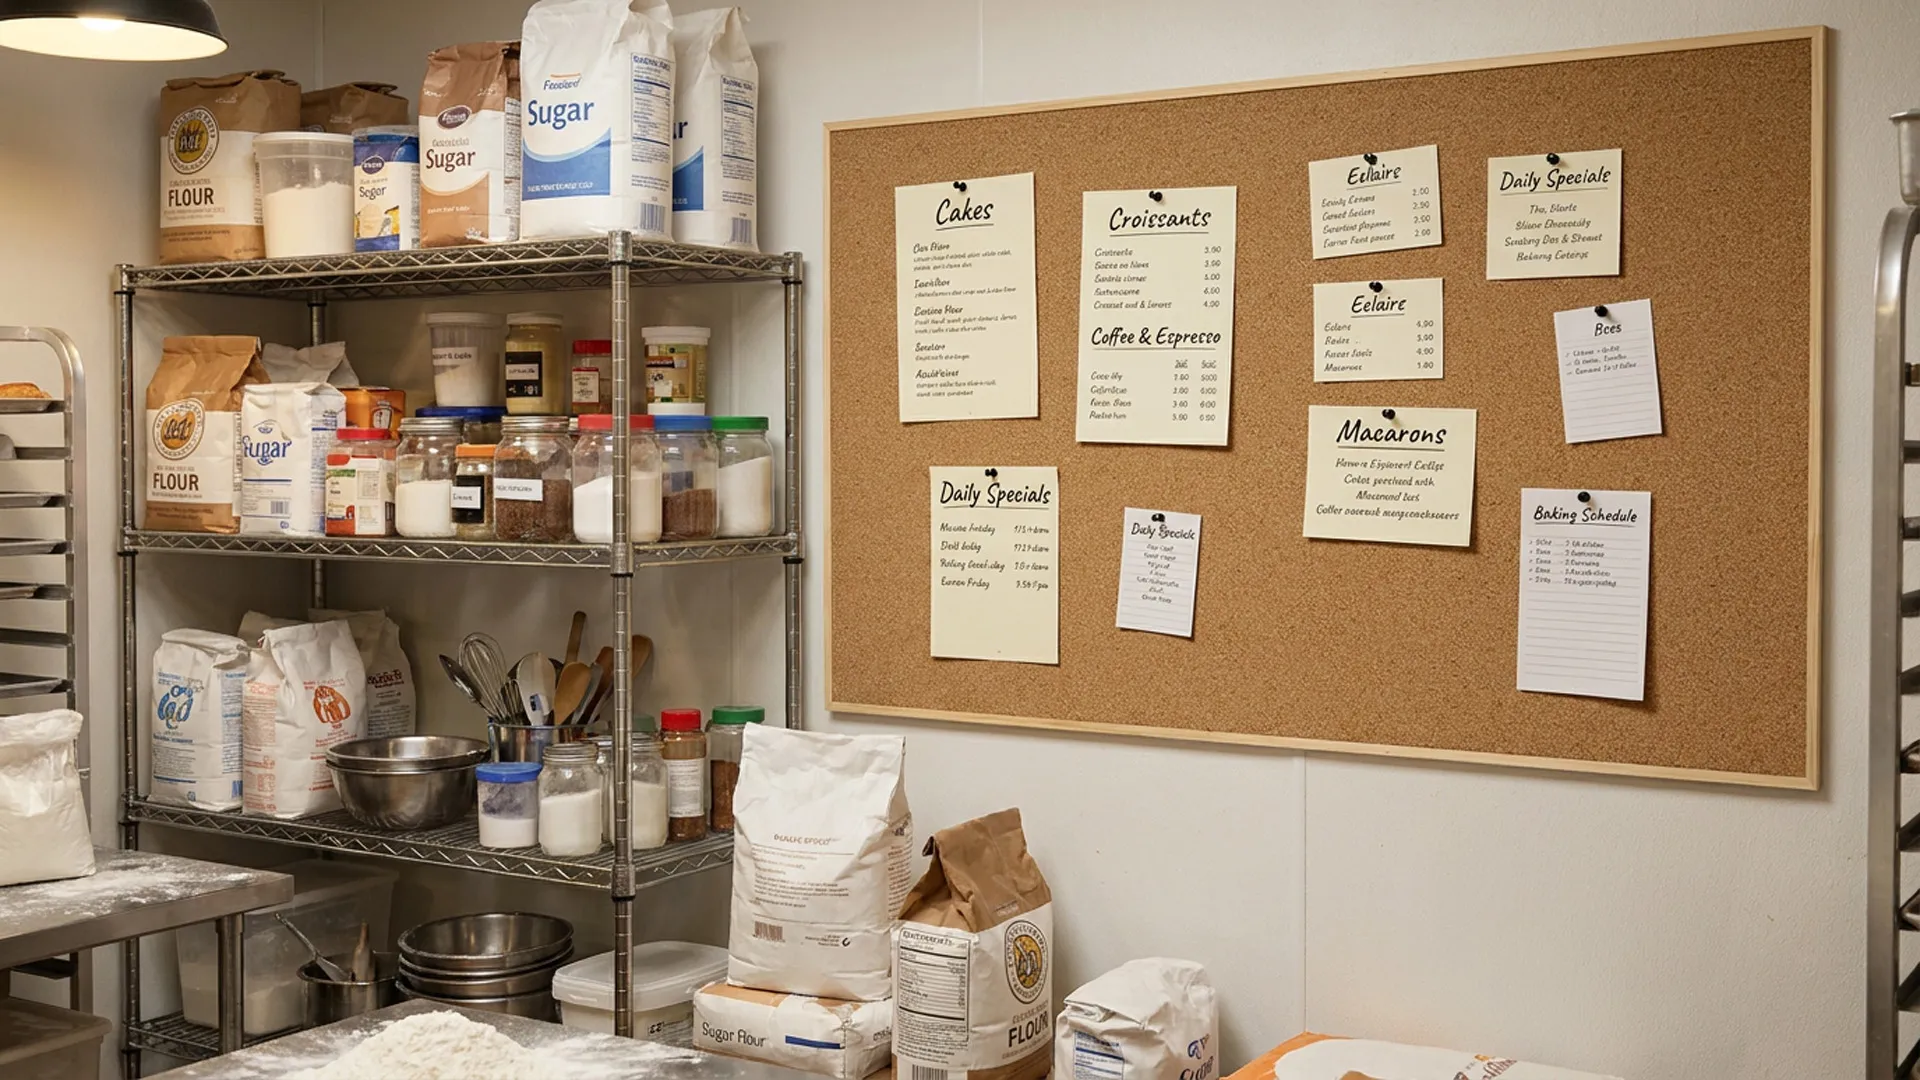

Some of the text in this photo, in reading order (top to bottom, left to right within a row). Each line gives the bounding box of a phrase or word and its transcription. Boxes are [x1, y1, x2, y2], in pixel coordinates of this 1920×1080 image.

[527, 100, 595, 130] Sugar
[426, 149, 476, 172] Sugar
[1500, 171, 1541, 192] Daily
[168, 188, 214, 207] FLOUR
[936, 198, 994, 225] Cakes
[1109, 207, 1212, 231] Croissants
[1139, 301, 1146, 309] &
[1091, 326, 1221, 349] Coffee & Espresso
[1336, 418, 1447, 444] Macarons
[153, 473, 199, 491] FLOUR
[940, 481, 1051, 508] Daily Specials
